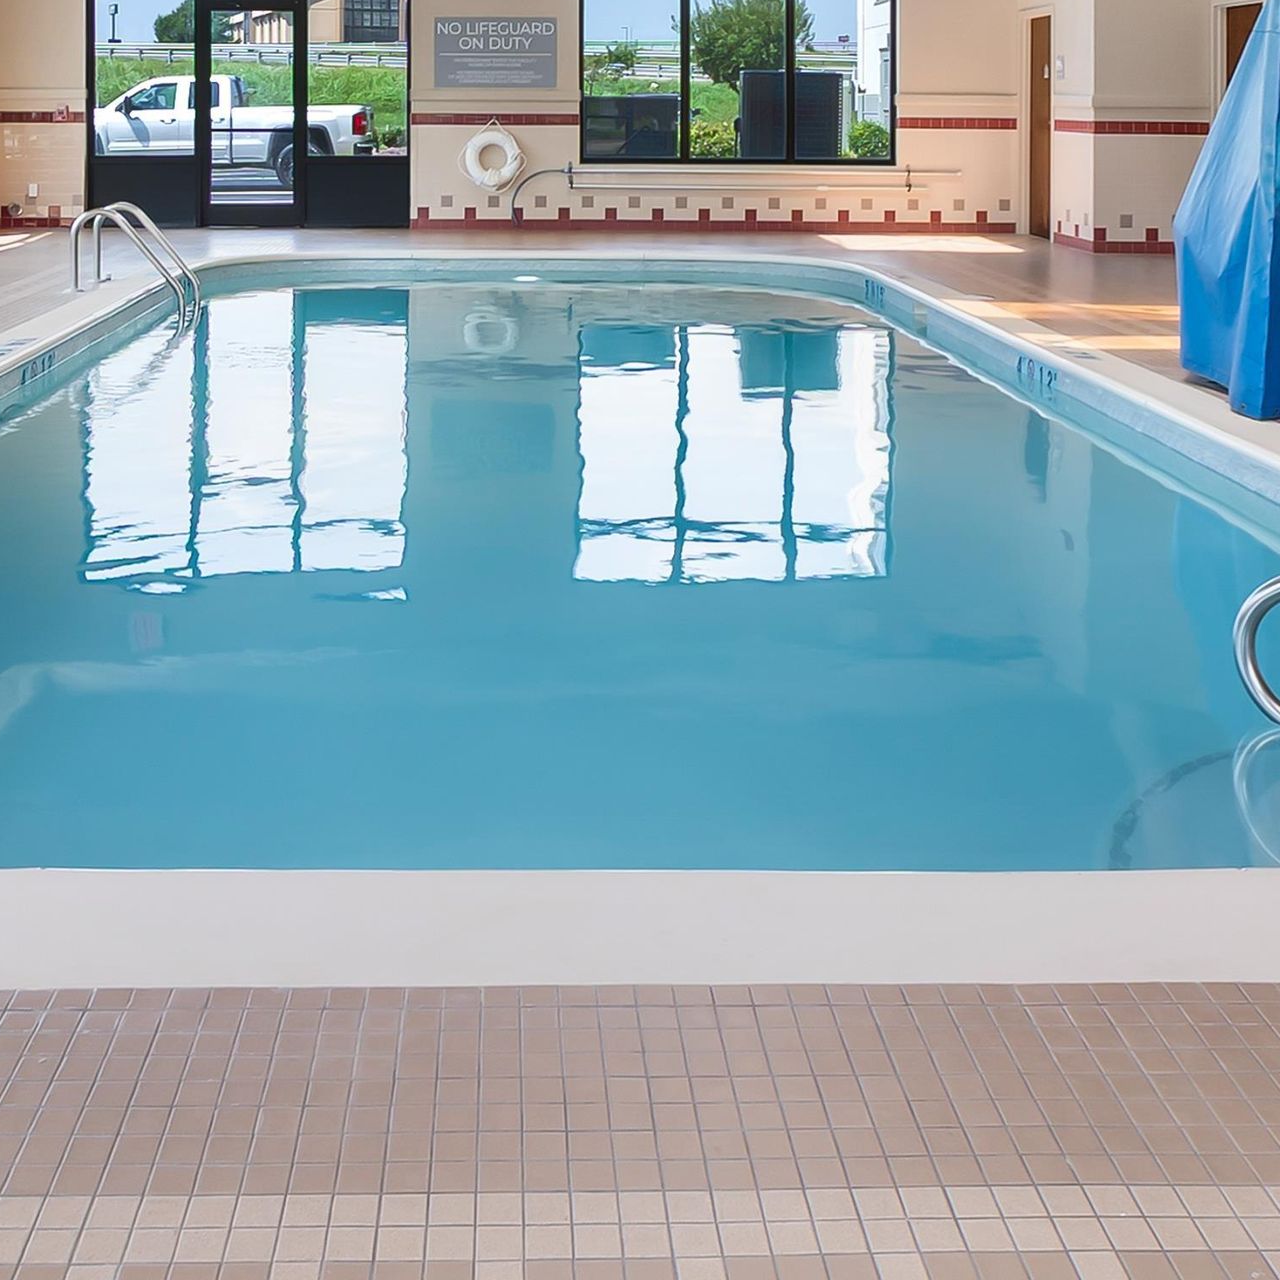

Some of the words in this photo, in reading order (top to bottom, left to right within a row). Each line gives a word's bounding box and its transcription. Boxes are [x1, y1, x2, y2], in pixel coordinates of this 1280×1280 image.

[437, 22, 462, 35] NO
[466, 22, 555, 35] LIFEGUARD
[458, 37, 484, 50] ON
[489, 37, 533, 50] DUTY
